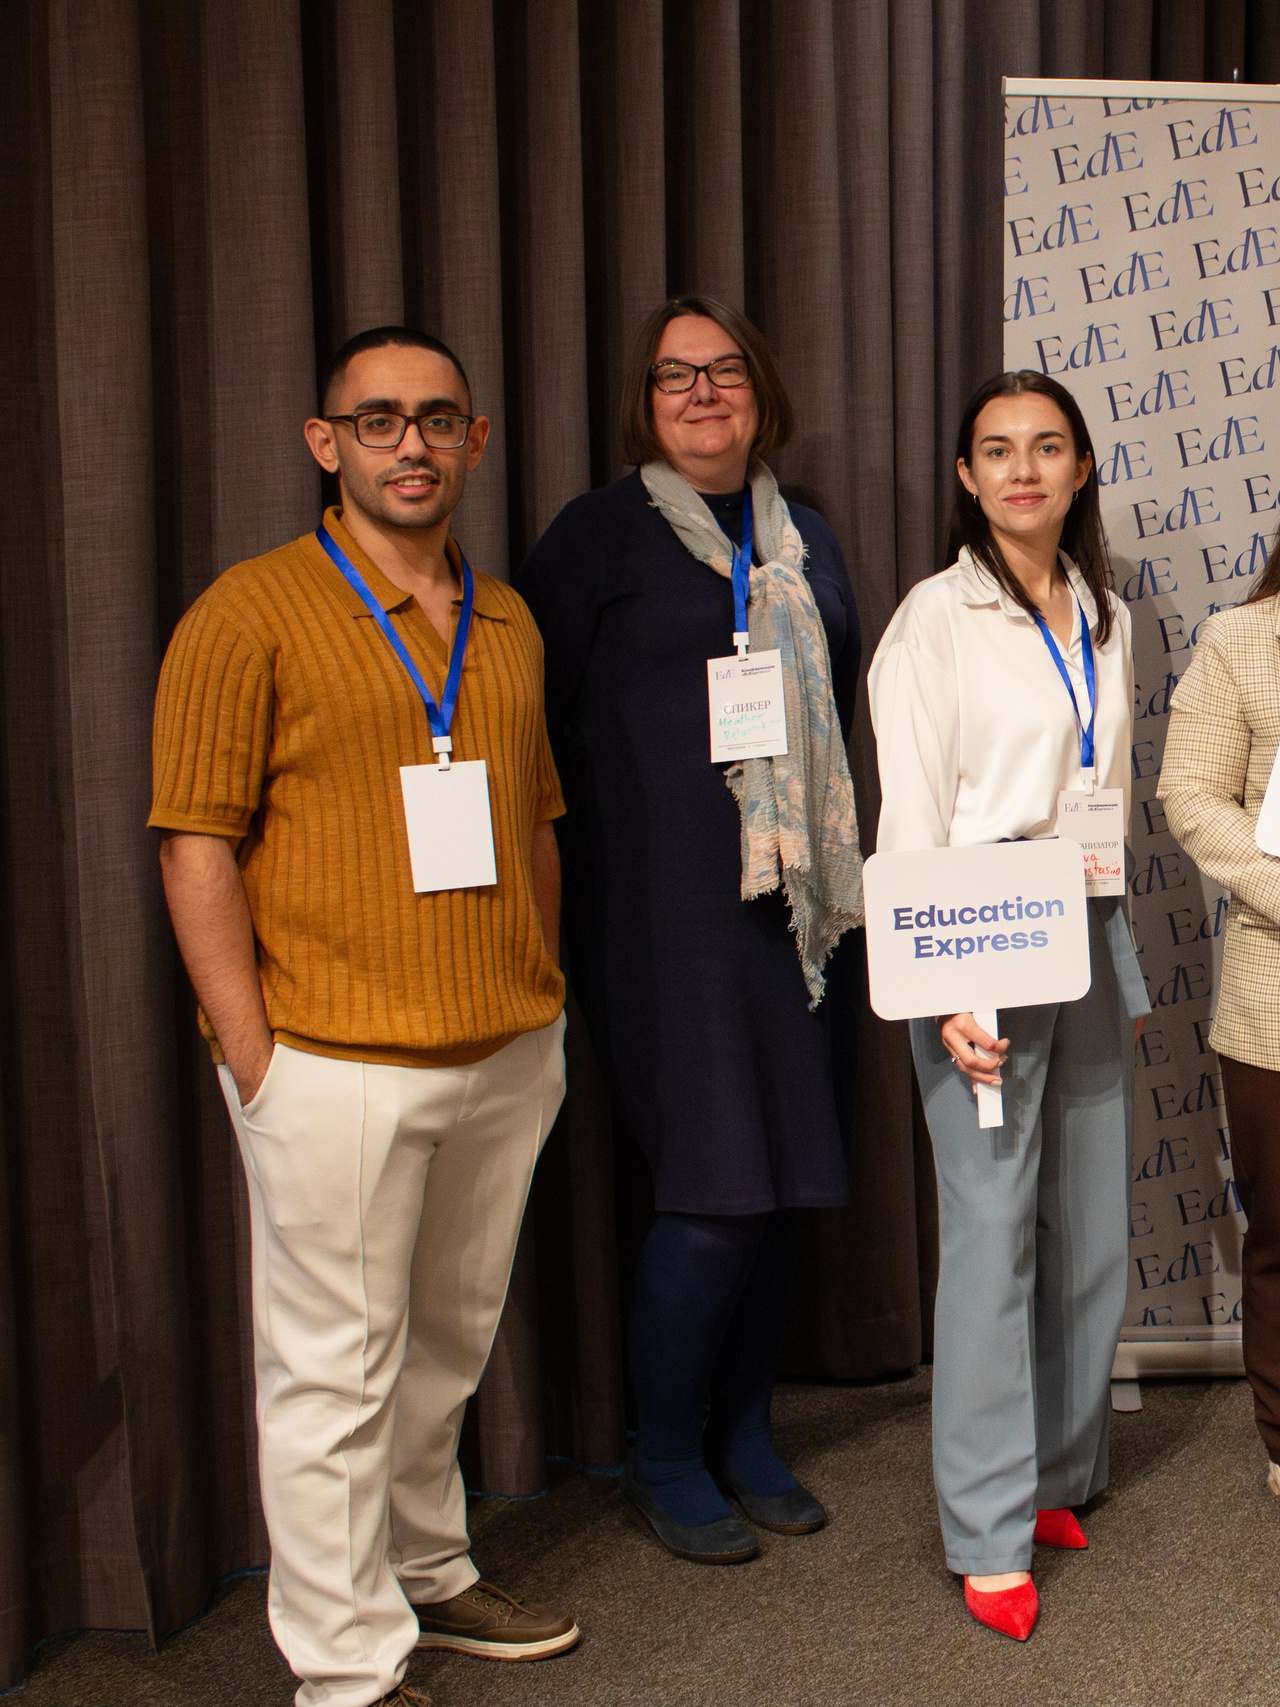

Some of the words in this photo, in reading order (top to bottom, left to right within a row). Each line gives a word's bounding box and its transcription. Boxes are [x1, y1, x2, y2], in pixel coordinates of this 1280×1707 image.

[1051, 130, 1143, 185] EdE
[1165, 107, 1258, 160] EdE
[1008, 203, 1099, 257] EdE
[1122, 179, 1214, 232] EdE
[1003, 276, 1055, 320] dE
[1078, 251, 1170, 304] EdE
[1035, 323, 1126, 375] EdE
[1149, 298, 1239, 351] EdE
[1104, 369, 1195, 422] EdE
[1098, 441, 1152, 487] dE
[1174, 415, 1265, 468] EdE
[1131, 486, 1221, 539] EdE
[1120, 557, 1178, 602] dE
[1156, 601, 1237, 654] Ed
[724, 700, 771, 714] СПИКЕР
[1078, 841, 1119, 850] АНИЗАТОР
[1083, 853, 1099, 863] va
[1133, 853, 1187, 897] dE
[893, 896, 1065, 930] Education
[1165, 897, 1230, 946] Ed
[914, 930, 1049, 959] Express
[1147, 963, 1213, 1009] dE
[1133, 1138, 1195, 1182] dE
[1174, 1177, 1243, 1226] Ed
[1134, 1241, 1219, 1290] EdE
